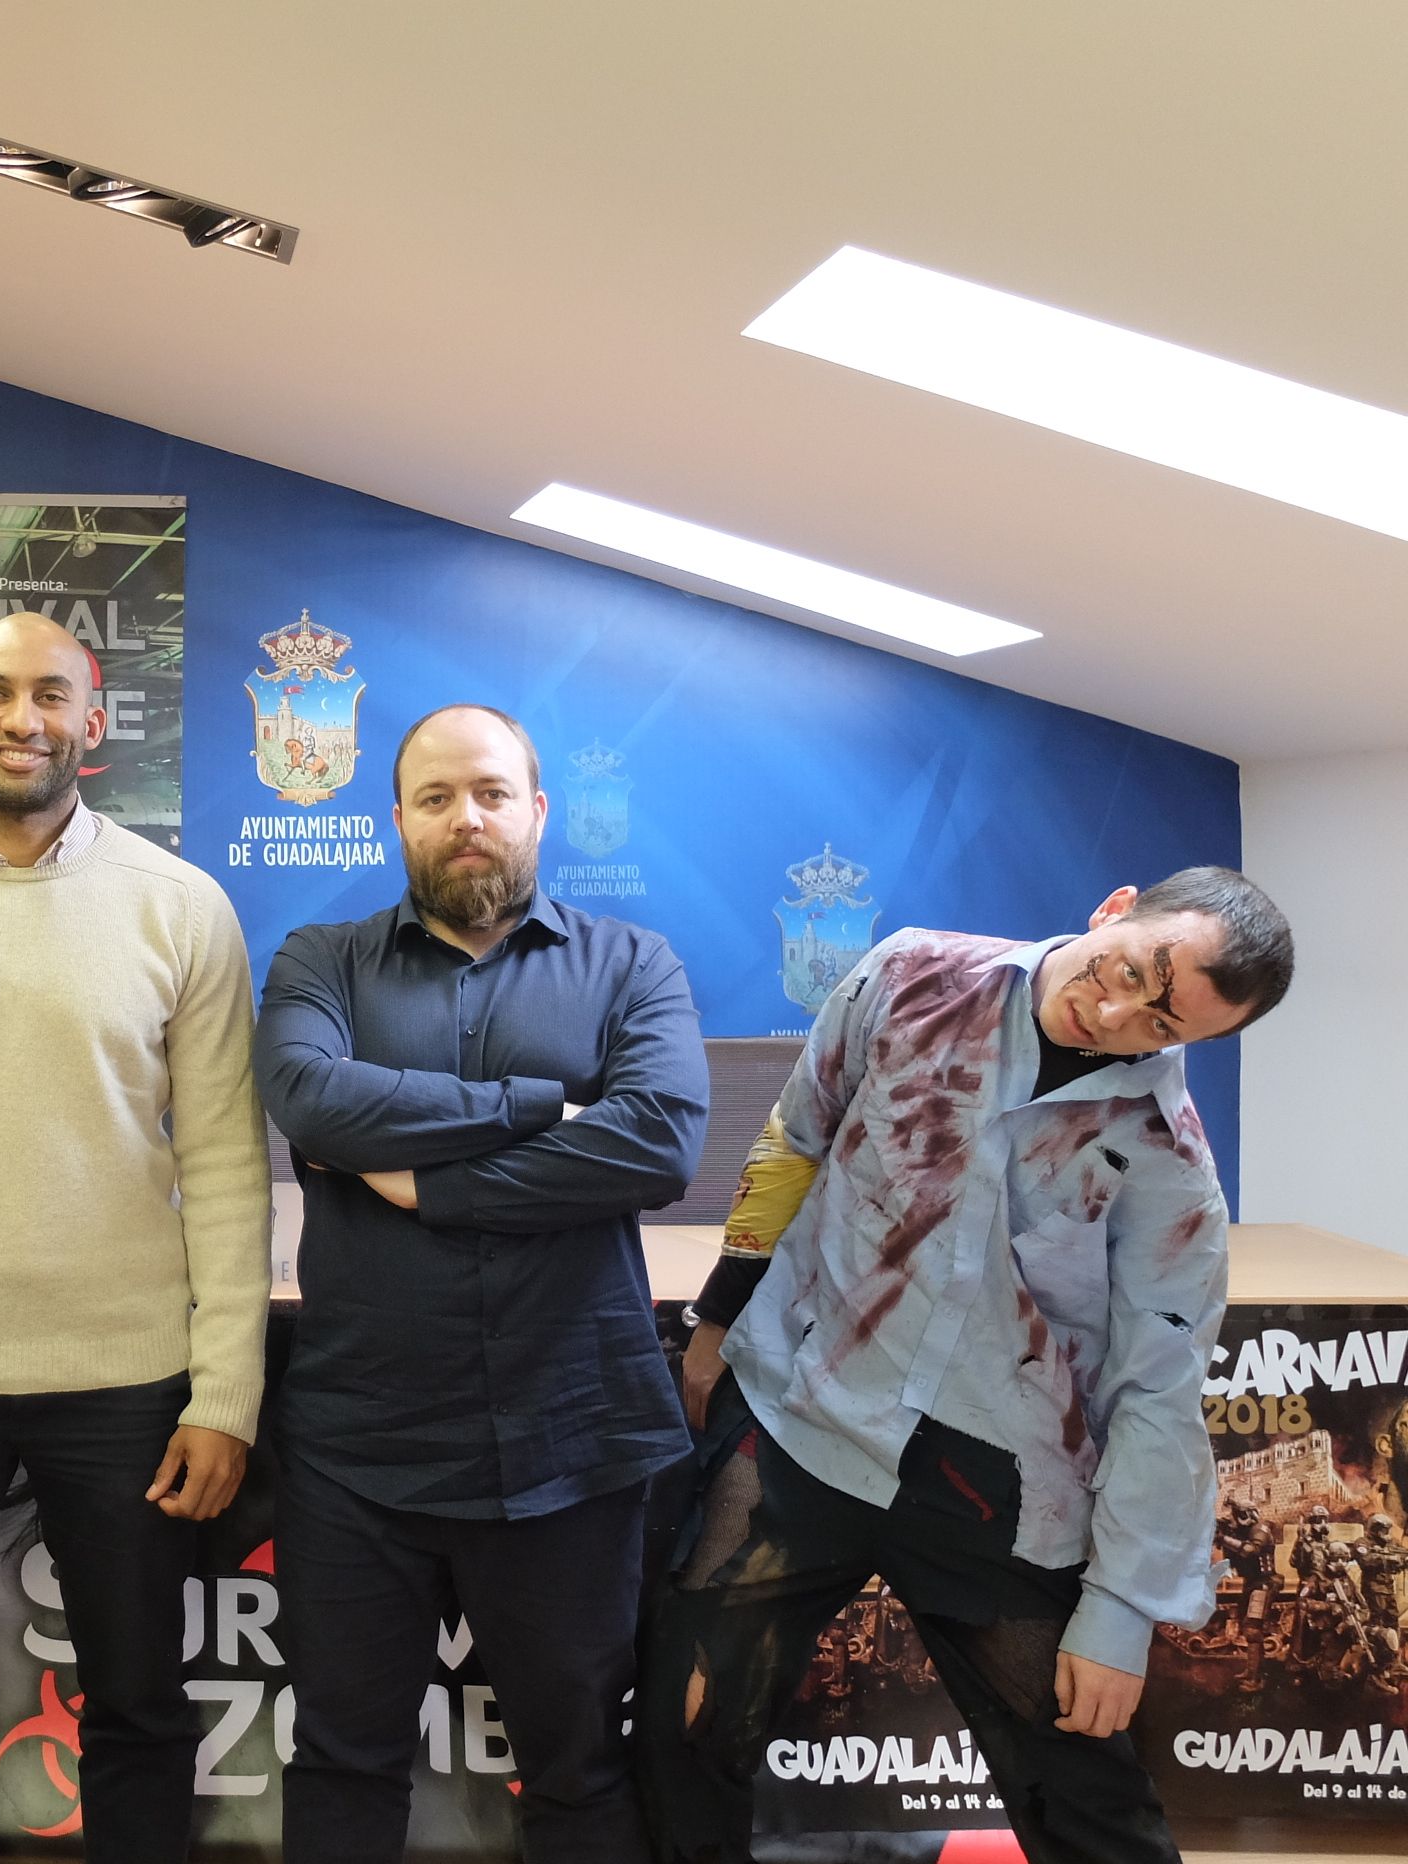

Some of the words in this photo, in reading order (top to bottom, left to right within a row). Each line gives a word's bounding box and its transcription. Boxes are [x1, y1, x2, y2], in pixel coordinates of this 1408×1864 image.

[240, 815, 374, 840] AYUNTAMIENTO
[228, 843, 252, 867] DE
[263, 842, 386, 873] GUADALAJARA
[556, 865, 640, 881] AYUNTAMIENTO
[549, 883, 564, 897] DE
[571, 883, 648, 900] GUADALAJARA
[1200, 1328, 1408, 1400] ARNAV
[1202, 1394, 1313, 1435] 2018
[1173, 1723, 1408, 1775] GUADALAJA
[901, 1794, 926, 1810] Del
[930, 1794, 940, 1810] 9
[945, 1794, 959, 1809] al
[963, 1794, 980, 1809] 14
[1303, 1783, 1328, 1798] Del
[1332, 1783, 1342, 1798] 9
[1347, 1784, 1361, 1798] al
[1366, 1784, 1382, 1799] 14
[1388, 1785, 1407, 1800] de
